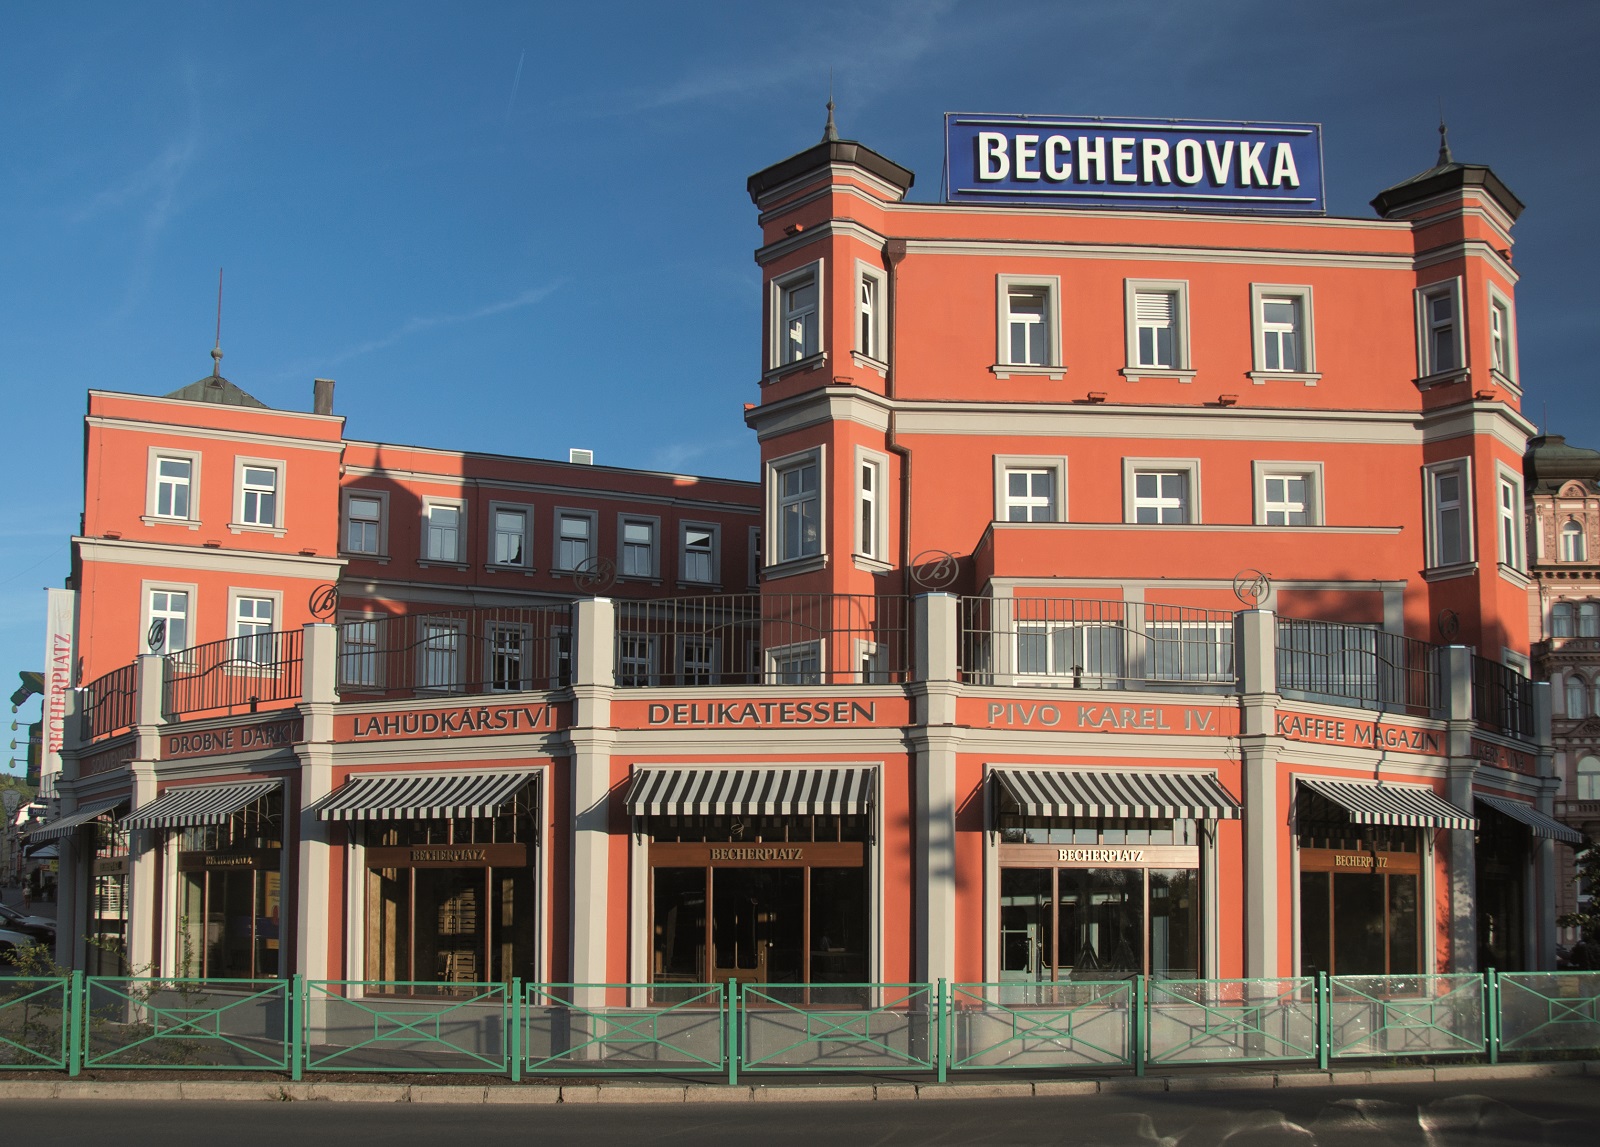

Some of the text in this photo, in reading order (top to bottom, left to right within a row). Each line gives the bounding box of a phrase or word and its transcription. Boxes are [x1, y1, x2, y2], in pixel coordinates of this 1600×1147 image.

[978, 131, 1300, 188] BECHEROVKA
[353, 705, 552, 737] LAHŮDKÁŘSTVÍ
[648, 701, 876, 725] DELIKATESSEN
[987, 702, 1216, 731] PIVO KAREL IV.
[169, 721, 299, 755] DROBNÉ DÁRKY
[1276, 713, 1440, 752] KAFFEE MAGAZIN
[411, 849, 486, 862] BECHERPLATZ
[709, 848, 803, 862] BECHERPLATZ
[1058, 849, 1145, 863] BECHERPLATZ
